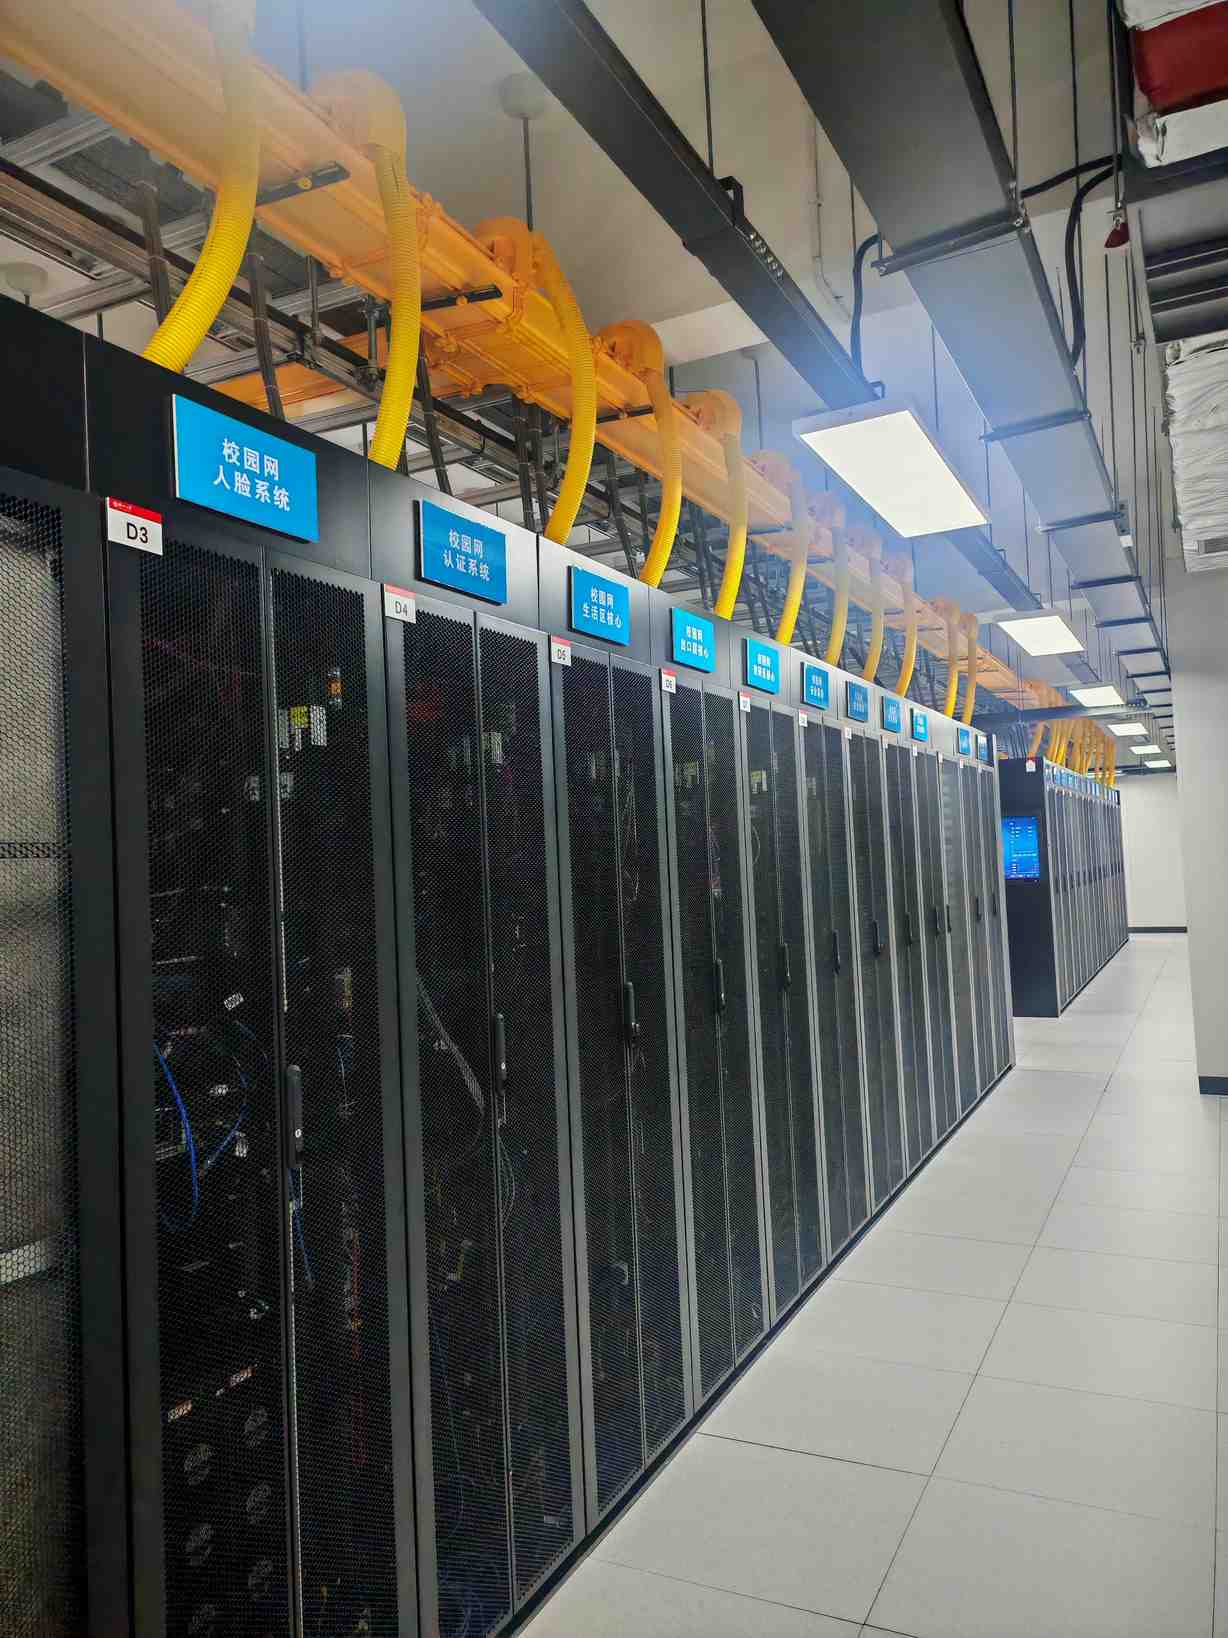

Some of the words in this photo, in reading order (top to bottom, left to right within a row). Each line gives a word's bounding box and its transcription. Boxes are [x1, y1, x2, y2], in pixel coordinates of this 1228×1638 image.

[222, 438, 279, 481] 校园网
[213, 465, 291, 512] 人脸系统
[127, 521, 149, 544] D3
[448, 528, 484, 559] 校园网
[443, 549, 491, 582] 认证系统
[394, 600, 409, 617] D4
